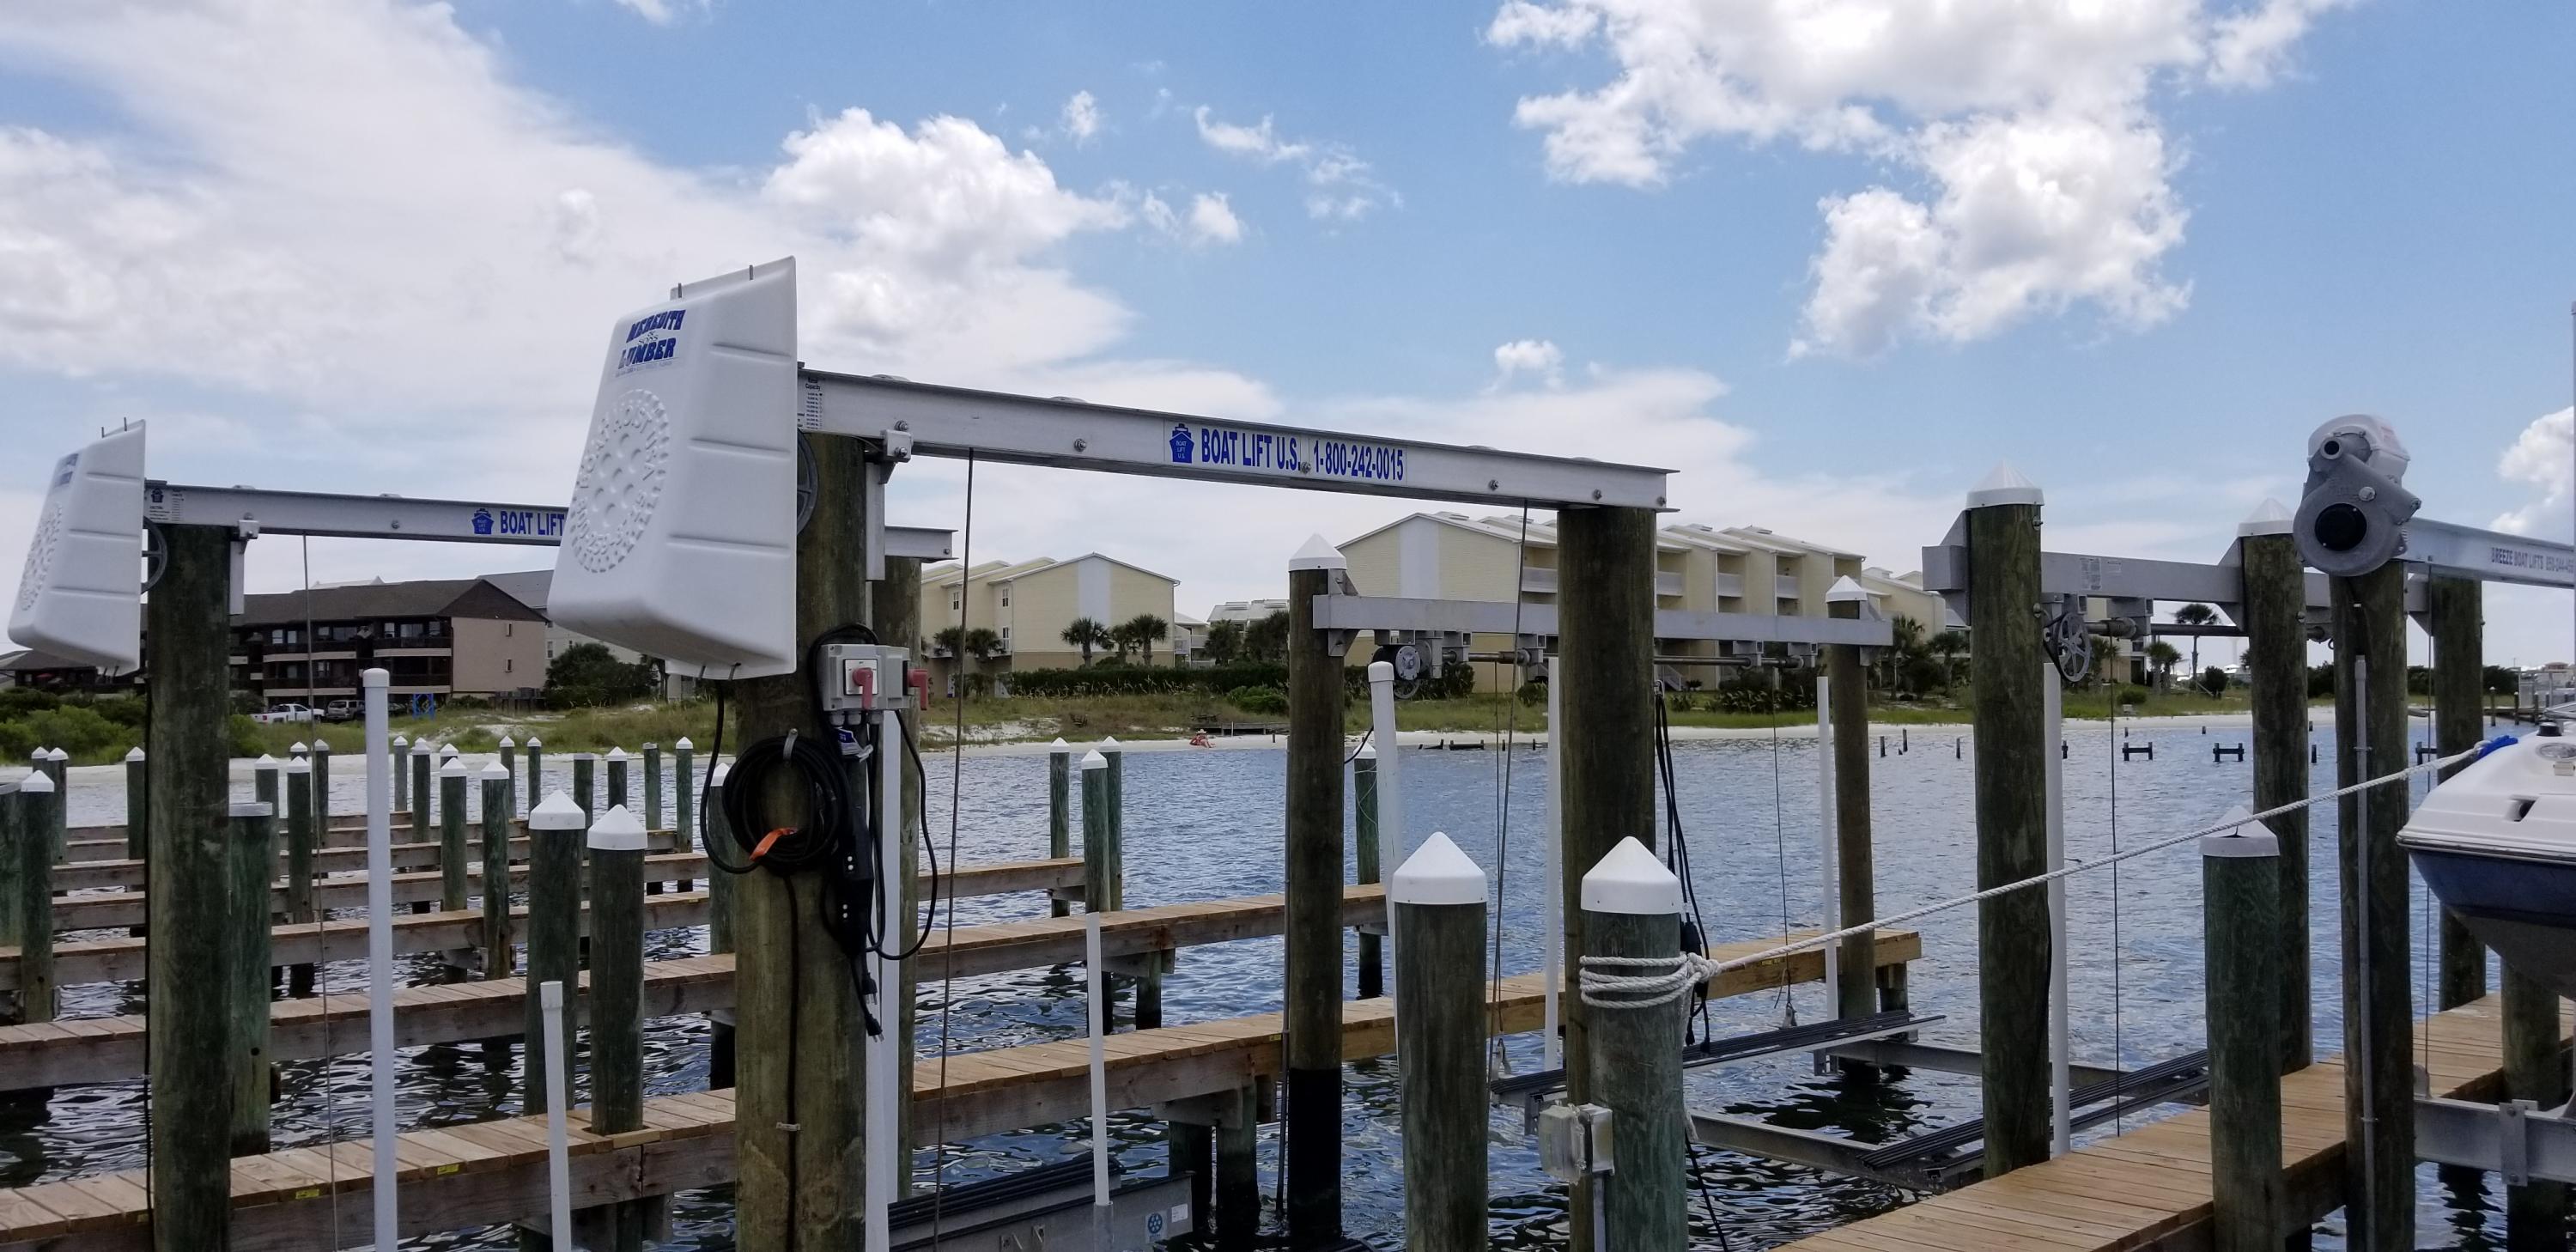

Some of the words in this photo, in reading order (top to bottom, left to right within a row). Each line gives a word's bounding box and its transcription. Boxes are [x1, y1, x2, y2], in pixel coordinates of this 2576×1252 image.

[618, 337, 677, 369] LUMBER
[1202, 428, 1237, 465] BOAT
[1242, 433, 1273, 468] LIFT
[1277, 436, 1302, 471] U.S.
[1314, 440, 1404, 481] 1-800-242-0015
[501, 511, 533, 534] BOAT
[538, 513, 565, 537] LIFT
